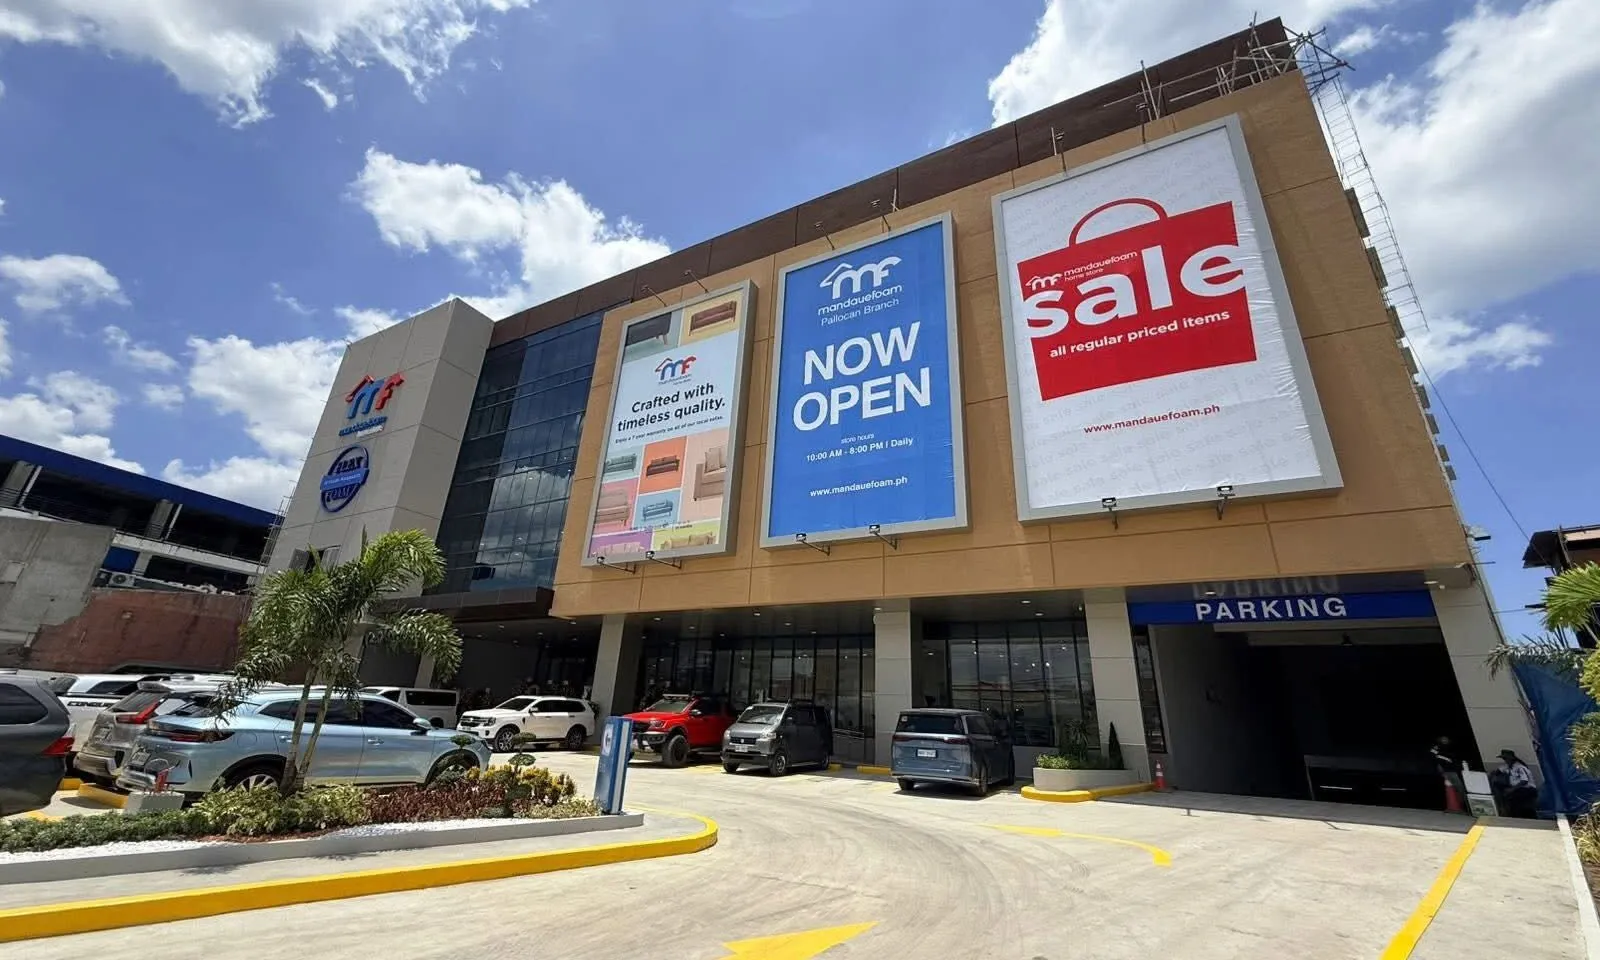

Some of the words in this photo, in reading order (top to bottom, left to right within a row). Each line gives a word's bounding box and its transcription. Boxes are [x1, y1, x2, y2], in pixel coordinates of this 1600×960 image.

[1063, 251, 1138, 277] mandauefoam
[1064, 272, 1085, 281] home
[1086, 267, 1104, 277] store
[818, 284, 902, 316] mandauefoam
[1024, 244, 1247, 338] sale
[821, 309, 861, 326] Pallocan
[864, 298, 900, 315] Branch
[1049, 345, 1067, 358] all
[1070, 333, 1123, 353] regular
[1127, 320, 1178, 343] priced
[1182, 310, 1231, 329] items
[803, 321, 921, 386] NOW
[631, 391, 680, 414] Crafted
[684, 383, 714, 400] with
[793, 366, 931, 431] OPEN
[617, 411, 670, 432] timeless
[674, 397, 726, 419] quality.
[1083, 404, 1221, 434] www.mandauefoam.ph
[806, 452, 828, 462] 10:00
[829, 449, 842, 458] AM
[849, 444, 868, 454] 8:00
[869, 441, 884, 451] PM
[891, 437, 914, 448] Daily
[841, 436, 857, 445] store
[857, 433, 875, 442] hours
[810, 475, 908, 497] www.mandauefoam.ph
[1195, 597, 1347, 621] PARKING
